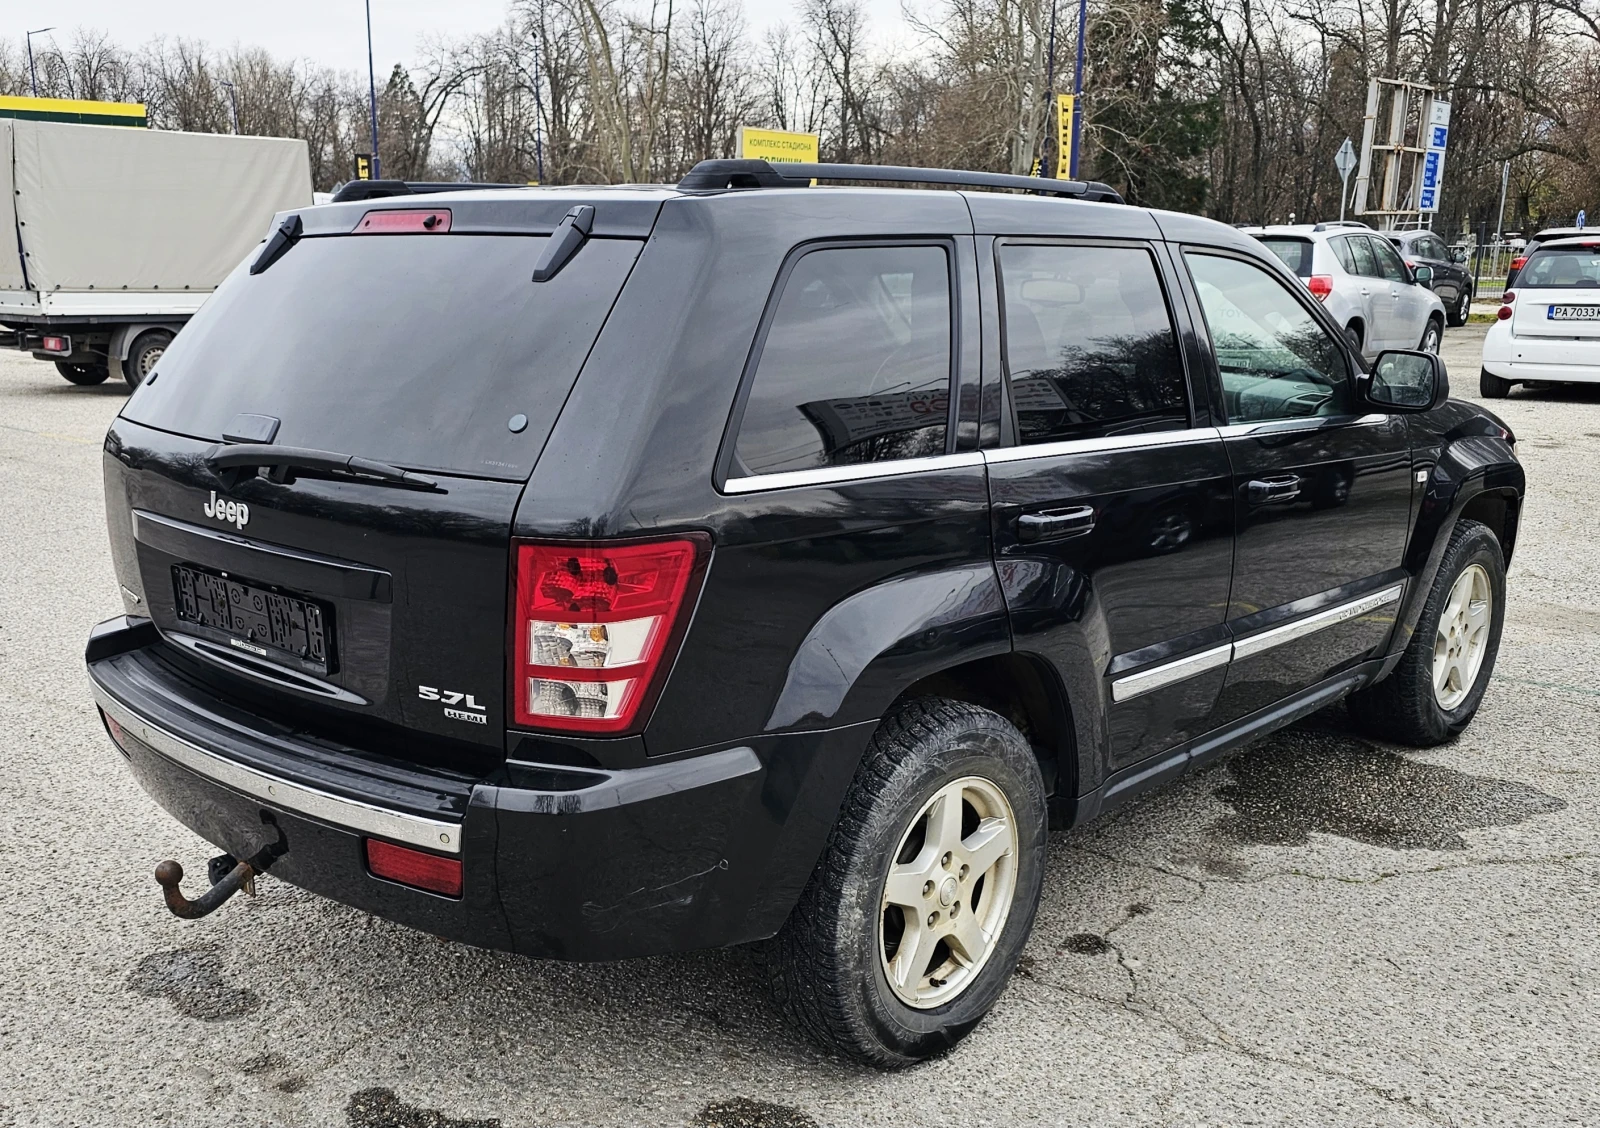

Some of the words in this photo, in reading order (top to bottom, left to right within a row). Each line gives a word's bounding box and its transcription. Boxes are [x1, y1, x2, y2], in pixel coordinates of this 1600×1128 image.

[749, 138, 781, 149] КОМПЛЕКС
[782, 141, 812, 151] СТАДИОНА
[1555, 307, 1568, 317] PA
[1570, 307, 1595, 317] 7033
[203, 490, 249, 530] Jeep
[418, 685, 486, 711] 5.7L
[446, 710, 485, 724] HEMI
